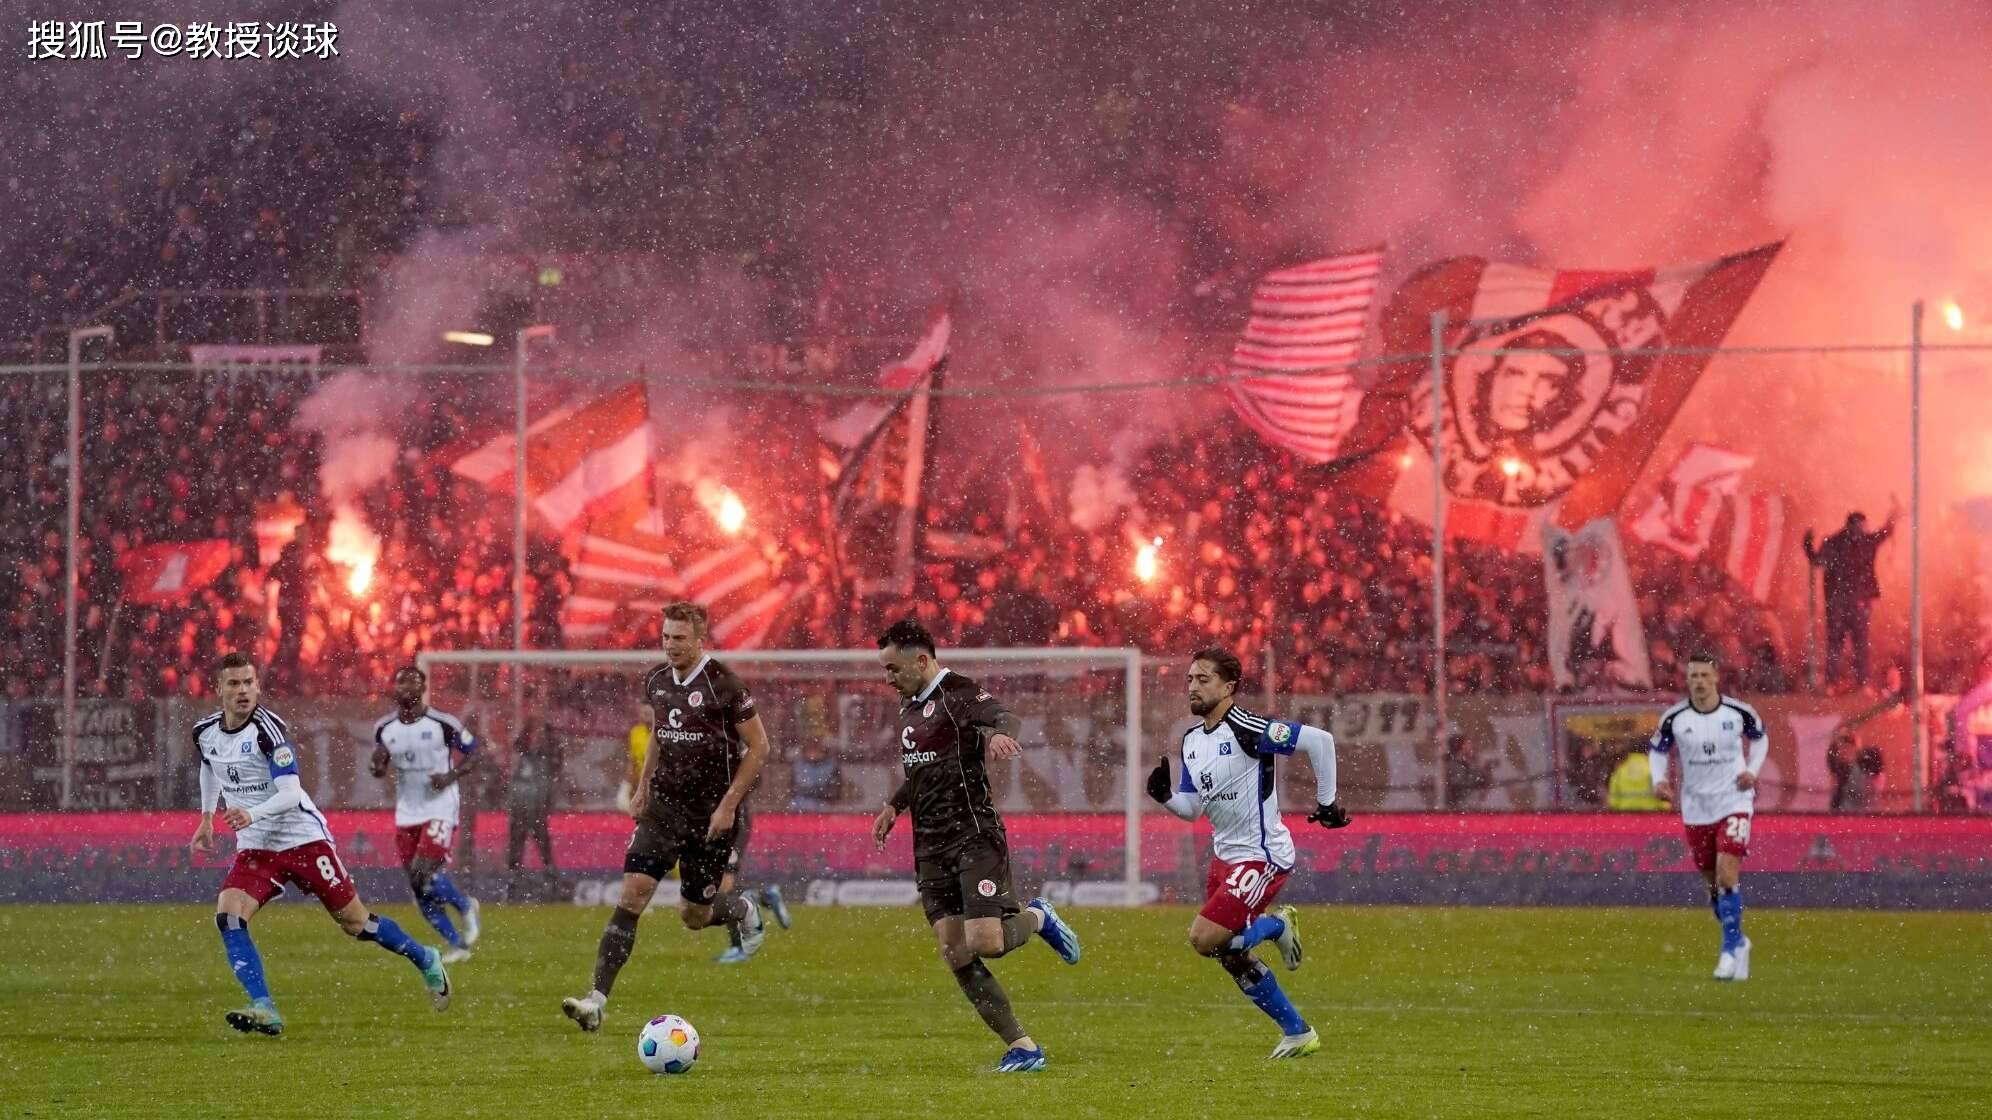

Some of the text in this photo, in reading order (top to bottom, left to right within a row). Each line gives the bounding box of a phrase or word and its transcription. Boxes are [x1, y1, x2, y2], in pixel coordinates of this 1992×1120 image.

[656, 728, 704, 744] congstar
[315, 854, 336, 881] 8
[1225, 863, 1260, 894] 10
